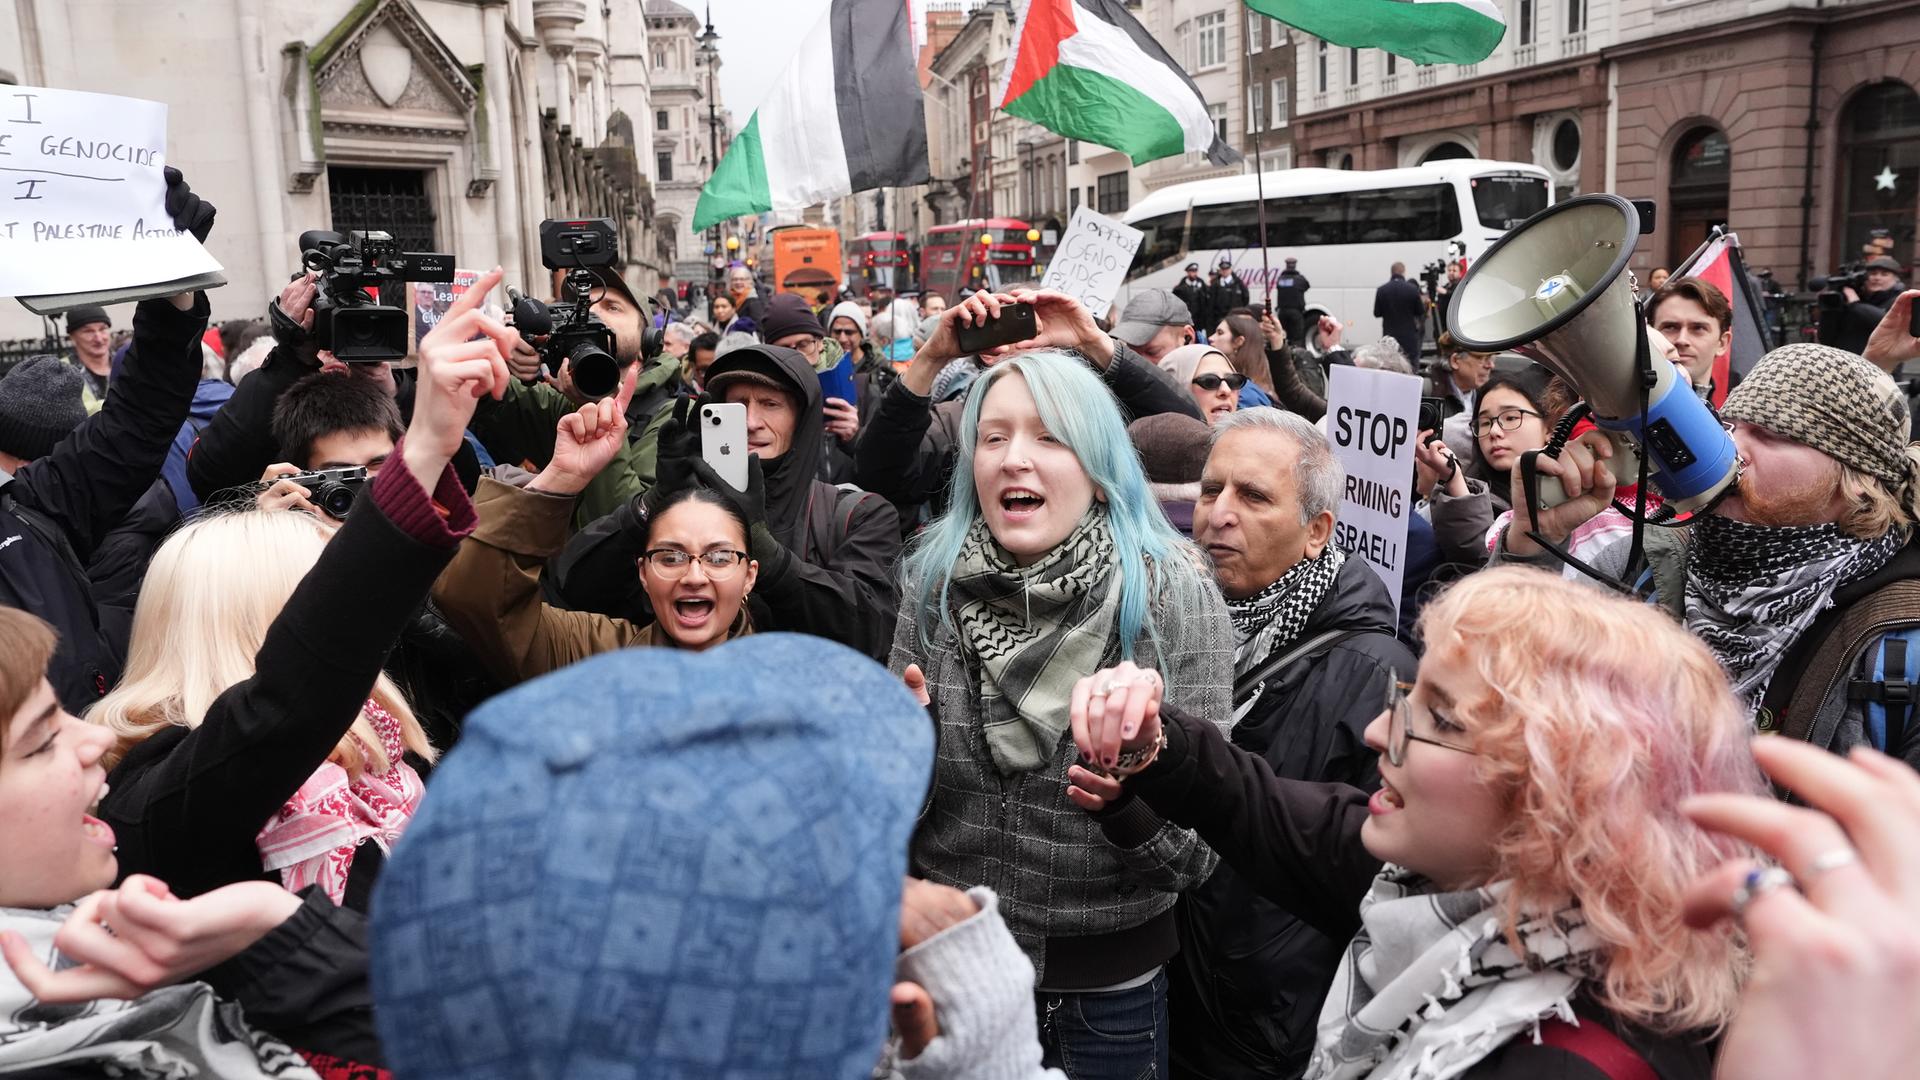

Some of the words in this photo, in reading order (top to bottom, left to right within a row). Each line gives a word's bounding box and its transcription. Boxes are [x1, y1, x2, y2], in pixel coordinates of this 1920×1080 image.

[1684, 47, 1736, 68] STRAND
[8, 93, 42, 124] I
[40, 135, 159, 167] GENOCIDE
[14, 179, 47, 200] I
[33, 221, 124, 242] PALESTINE
[1057, 258, 1103, 288] CIDE
[1335, 405, 1408, 460] STOP
[1344, 474, 1401, 519] RMING
[1334, 520, 1397, 571] SRAEL!
